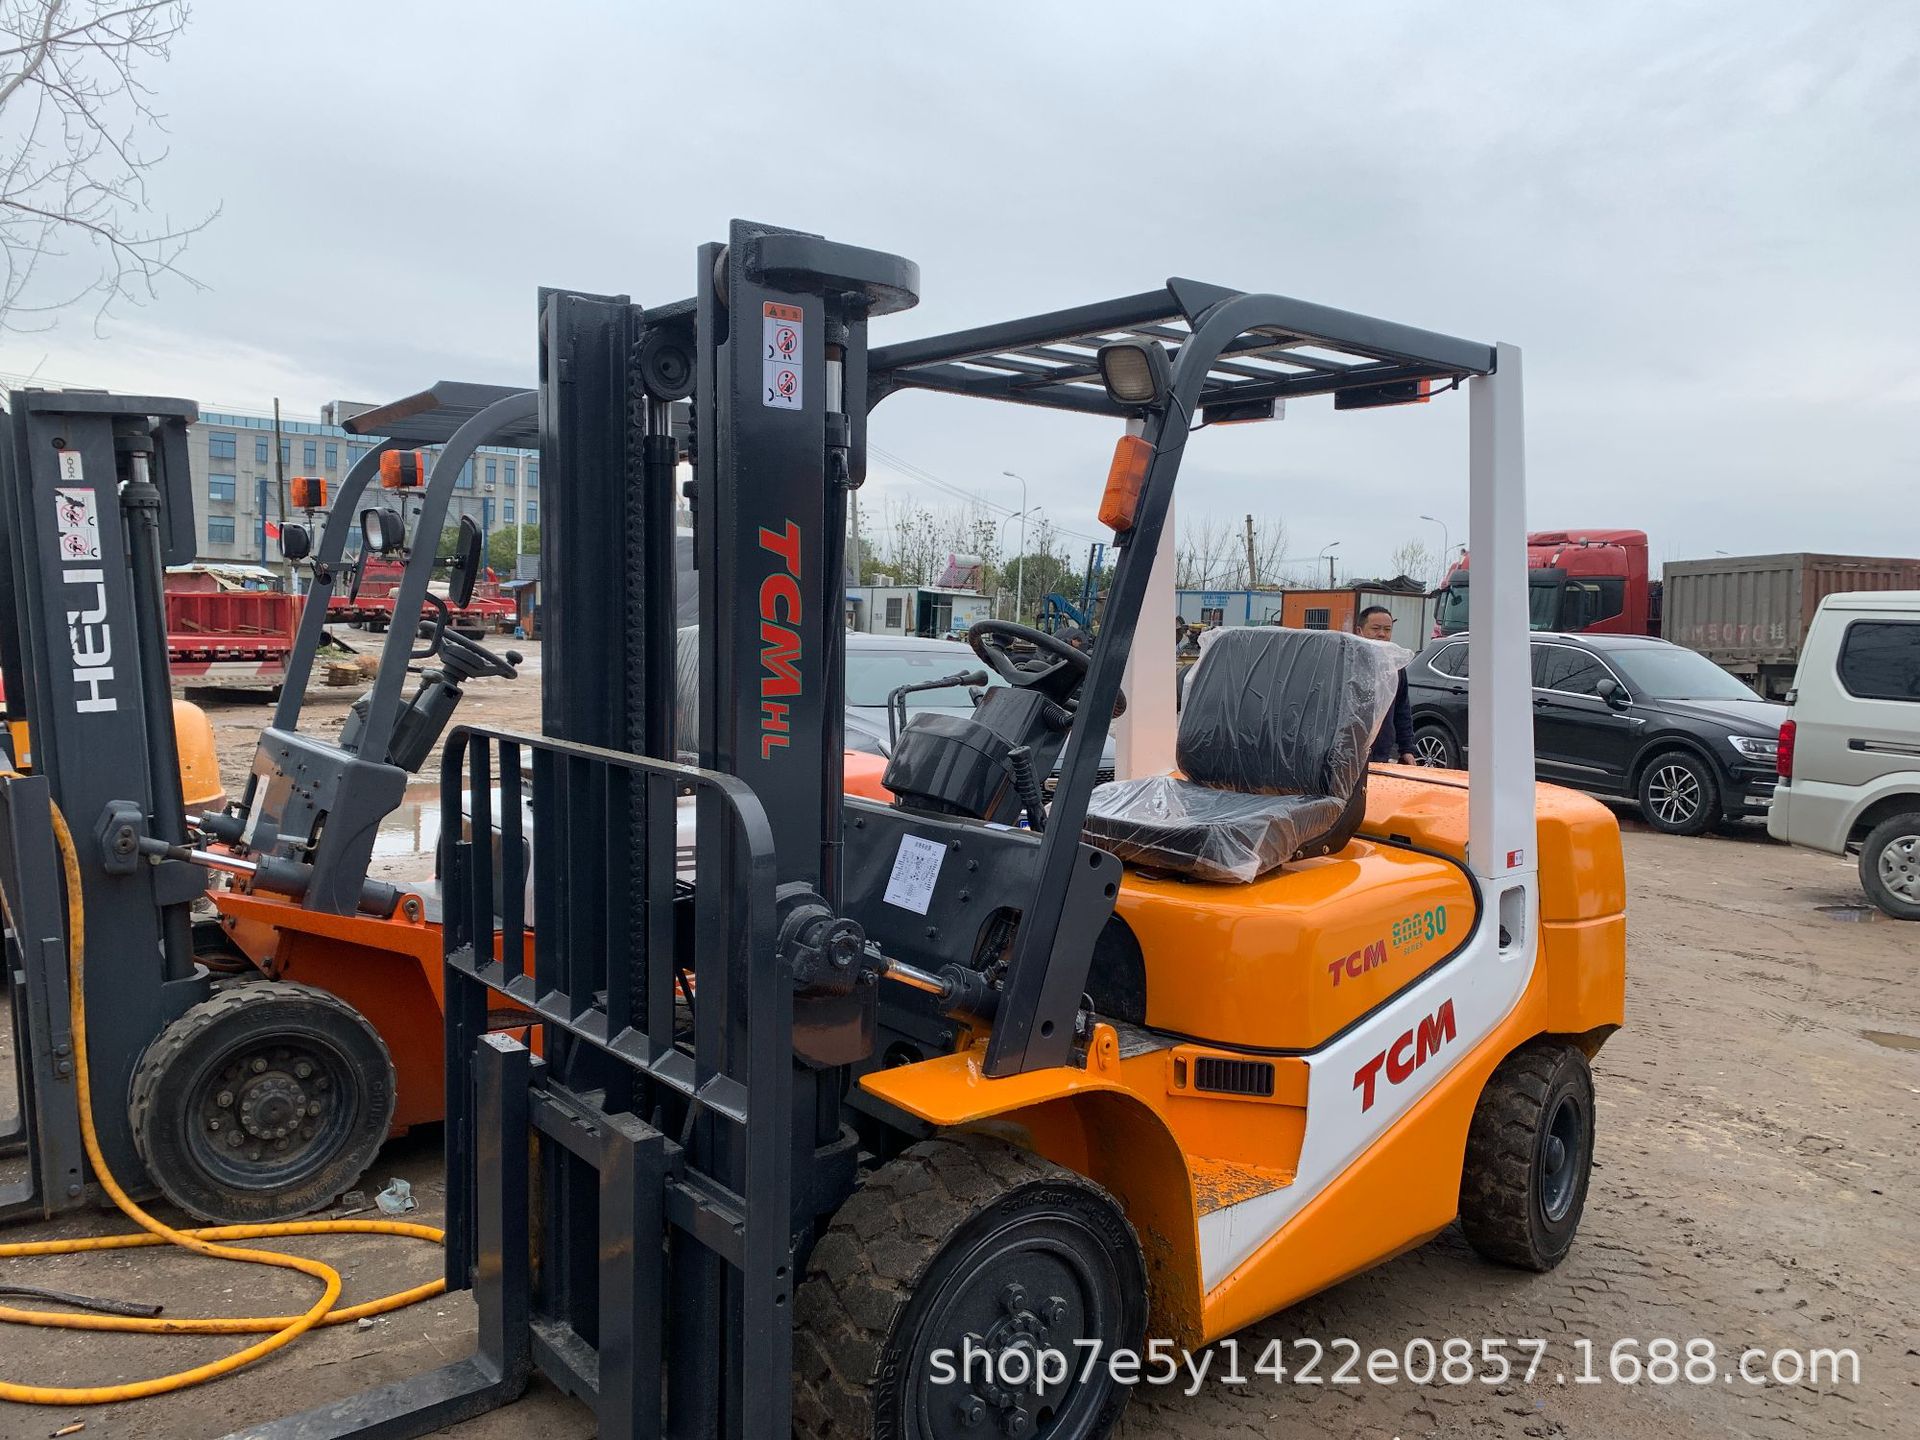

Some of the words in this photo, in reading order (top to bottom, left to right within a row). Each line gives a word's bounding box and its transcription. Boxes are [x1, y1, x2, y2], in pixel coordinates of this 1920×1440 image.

[62, 568, 117, 713] HELI
[1327, 938, 1388, 988] TCM
[1423, 904, 1447, 941] 30
[1352, 997, 1457, 1114] TCM
